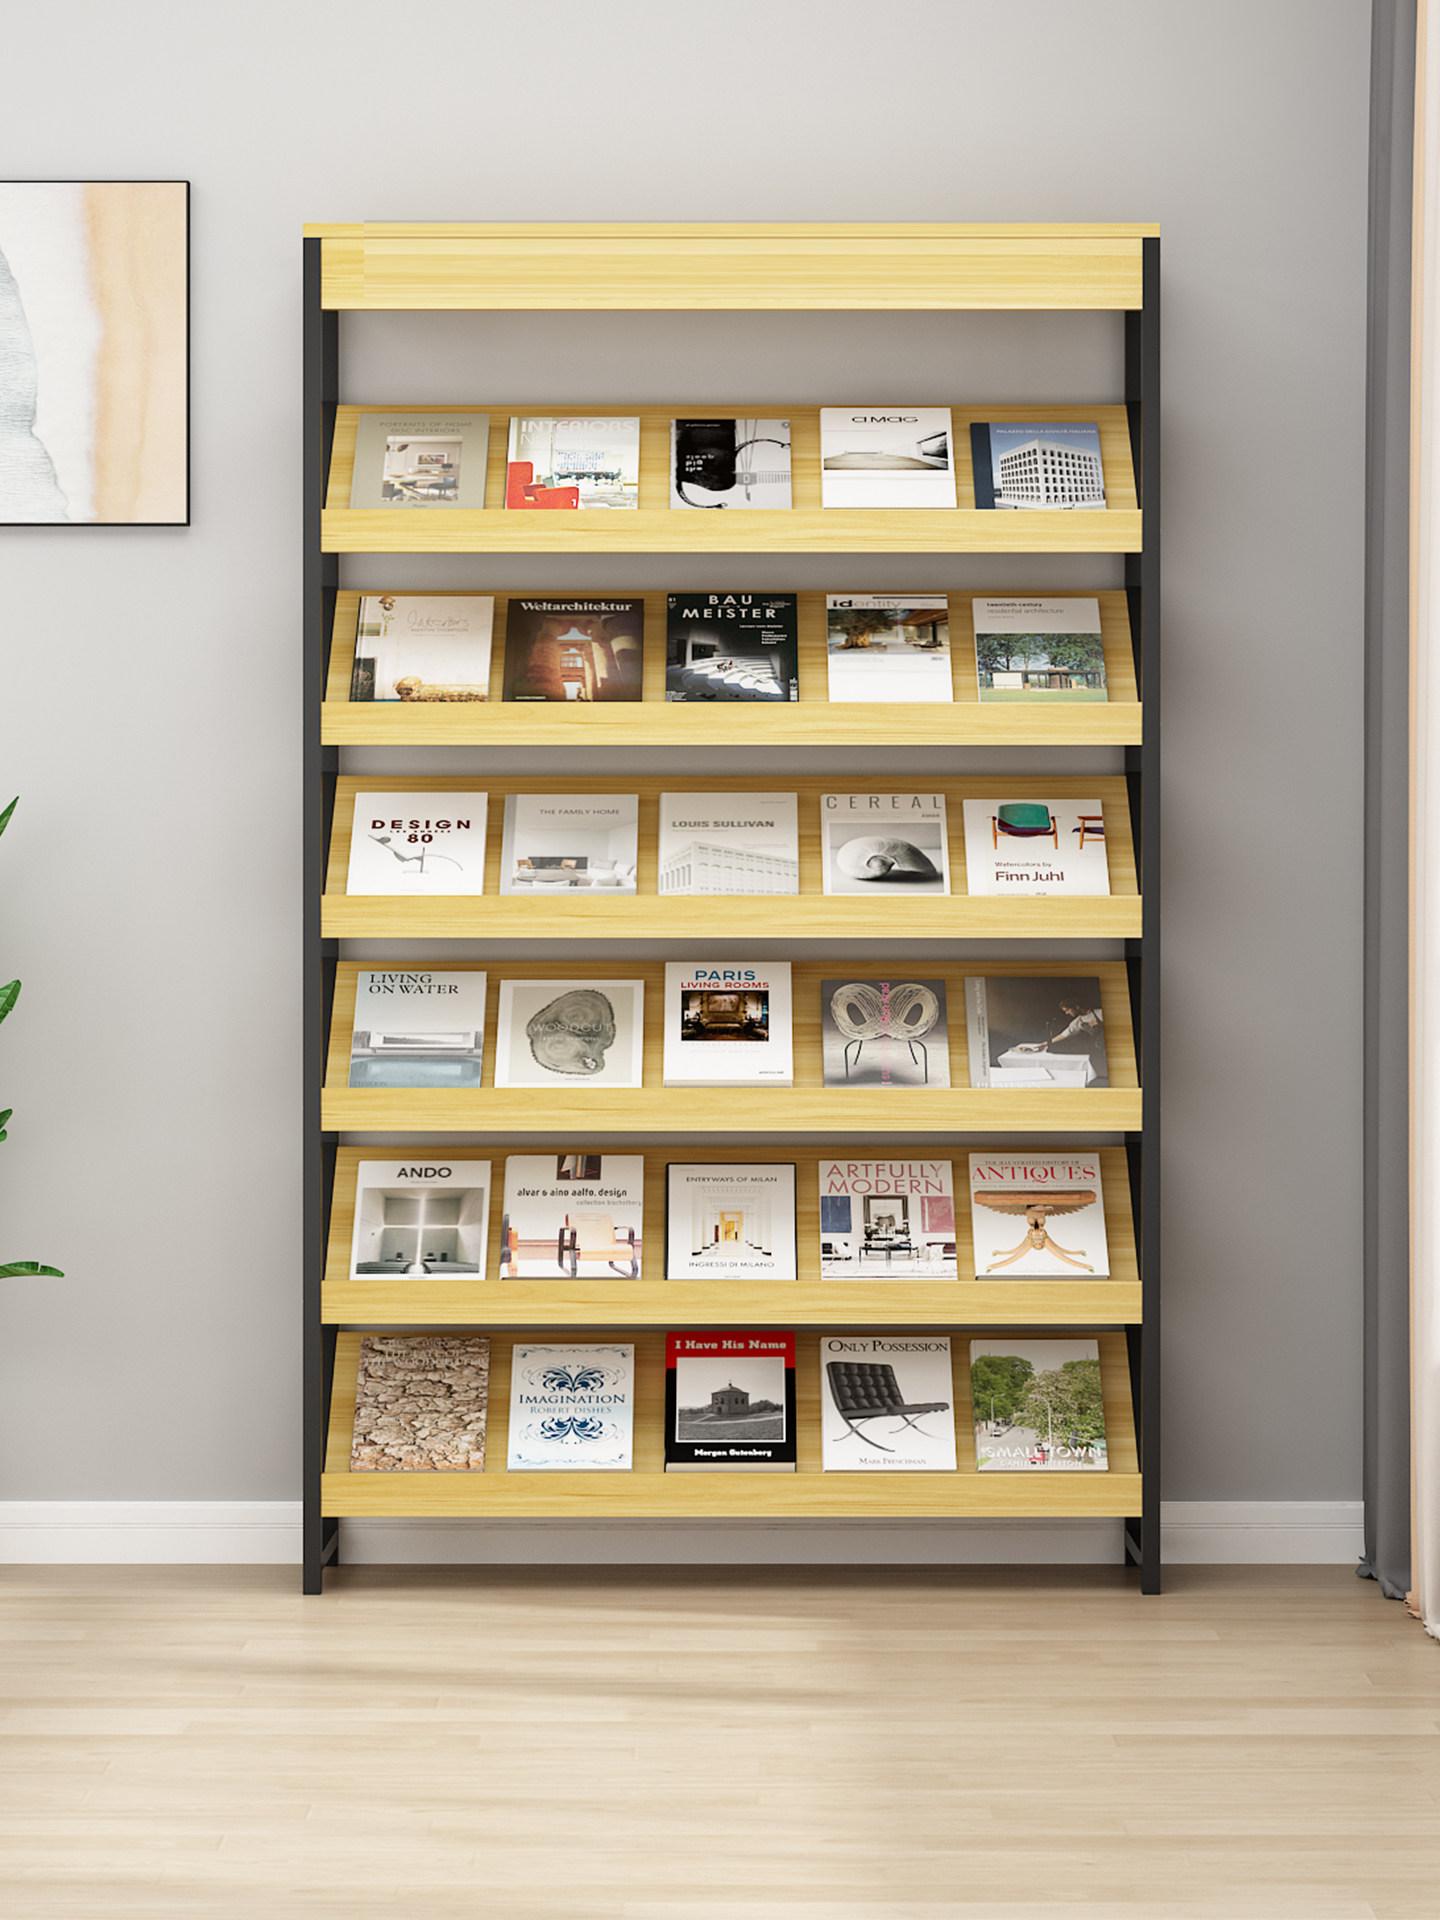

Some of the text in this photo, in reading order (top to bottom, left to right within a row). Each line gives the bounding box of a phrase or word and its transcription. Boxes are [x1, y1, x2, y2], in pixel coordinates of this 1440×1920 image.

[521, 420, 635, 433] INTERIORS
[709, 594, 752, 605] BAU
[833, 599, 901, 609] identity
[521, 602, 632, 611] Weltarchitektur
[682, 608, 776, 618] MEISTER
[826, 795, 943, 809] CEREAL
[371, 819, 471, 829] DESIGN
[672, 820, 775, 828] LOUIS SULLIVAN
[407, 833, 433, 844] 80
[995, 871, 1065, 882] Finn Juhl
[369, 974, 433, 984] LIVING
[695, 970, 756, 981] PARIS
[368, 984, 460, 994] ON WATER
[396, 1167, 453, 1178] ANDO
[826, 1163, 944, 1178] ARTFULLY
[972, 1166, 1097, 1184] ANTIQUES
[827, 1179, 944, 1194] MODERN
[517, 1188, 540, 1197] alvar
[550, 1188, 569, 1197] aino
[598, 1188, 628, 1198] design
[675, 1340, 786, 1350] I Have His Name
[828, 1339, 948, 1353] ONLY POSSESSION
[519, 1394, 625, 1404] IMAGINATION
[694, 1448, 772, 1457] Morgan Gutenberg
[985, 1446, 1102, 1458] SMALL TOWN
